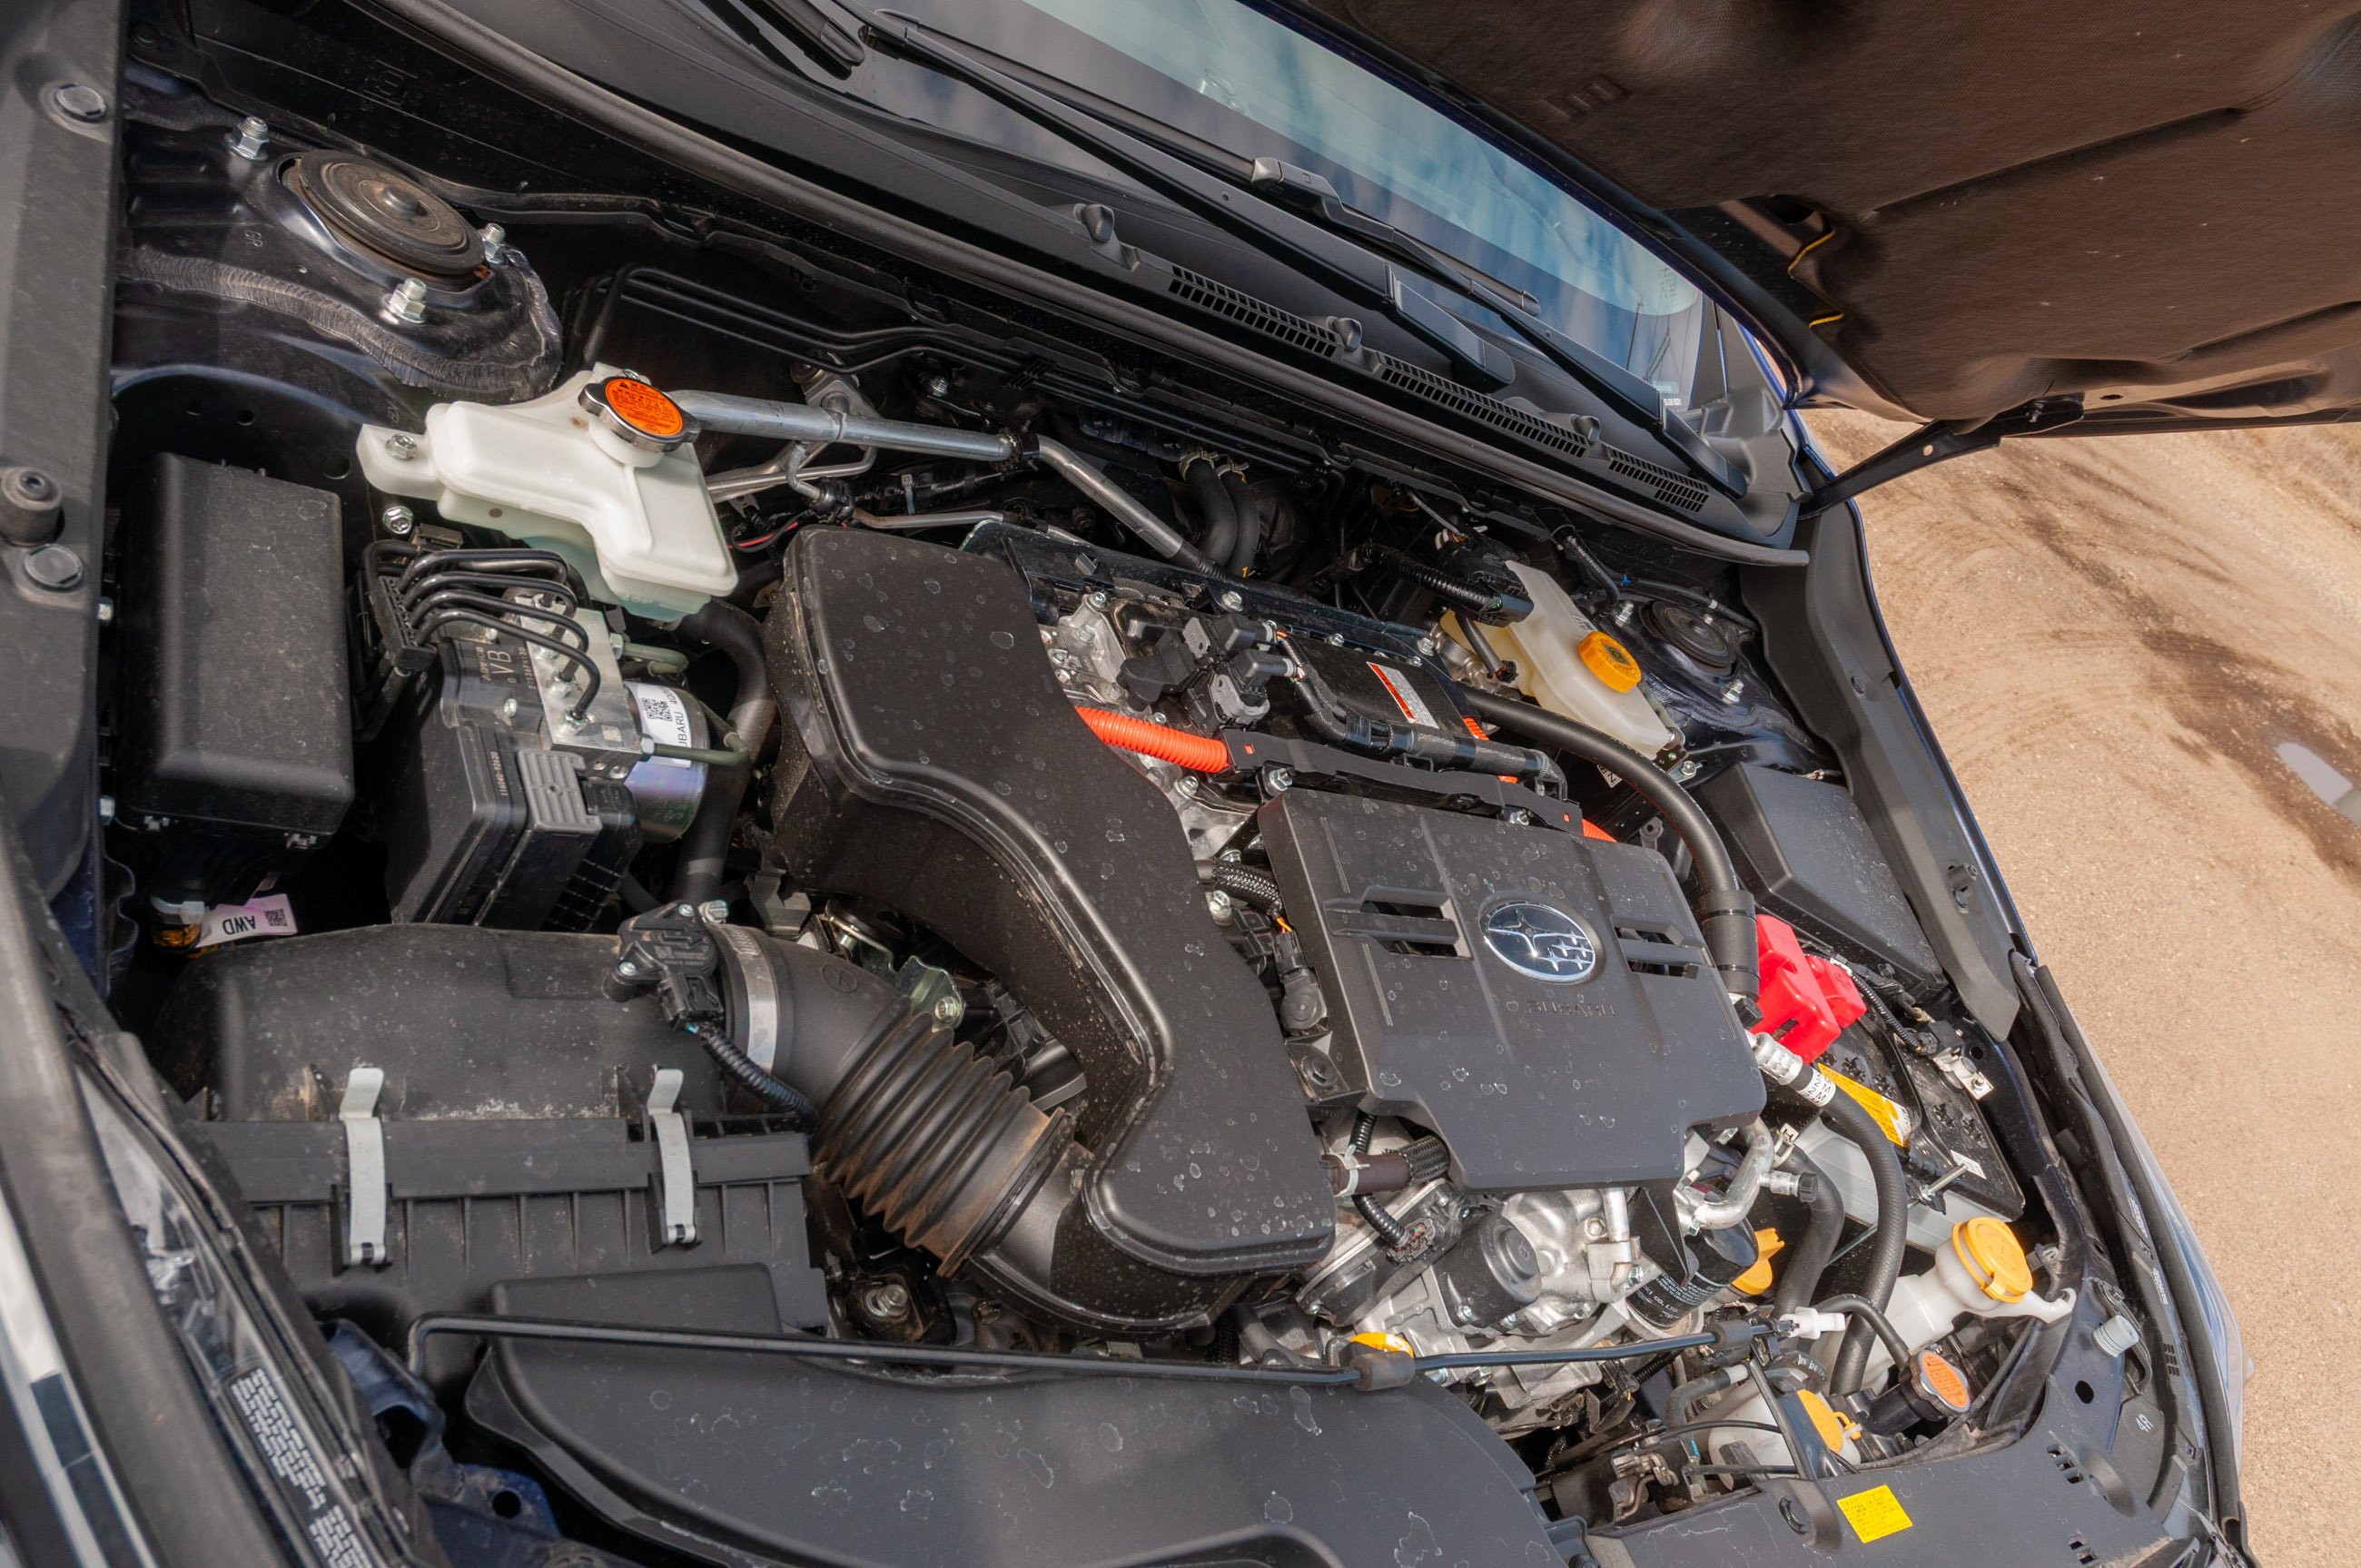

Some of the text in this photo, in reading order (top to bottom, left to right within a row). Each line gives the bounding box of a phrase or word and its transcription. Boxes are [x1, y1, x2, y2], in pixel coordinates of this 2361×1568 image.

[487, 649, 515, 675] VB
[674, 711, 689, 747] UBARU
[222, 915, 257, 936] AWD
[1526, 1000, 1618, 1018] SUBARU
[2135, 1413, 2156, 1434] 4R
